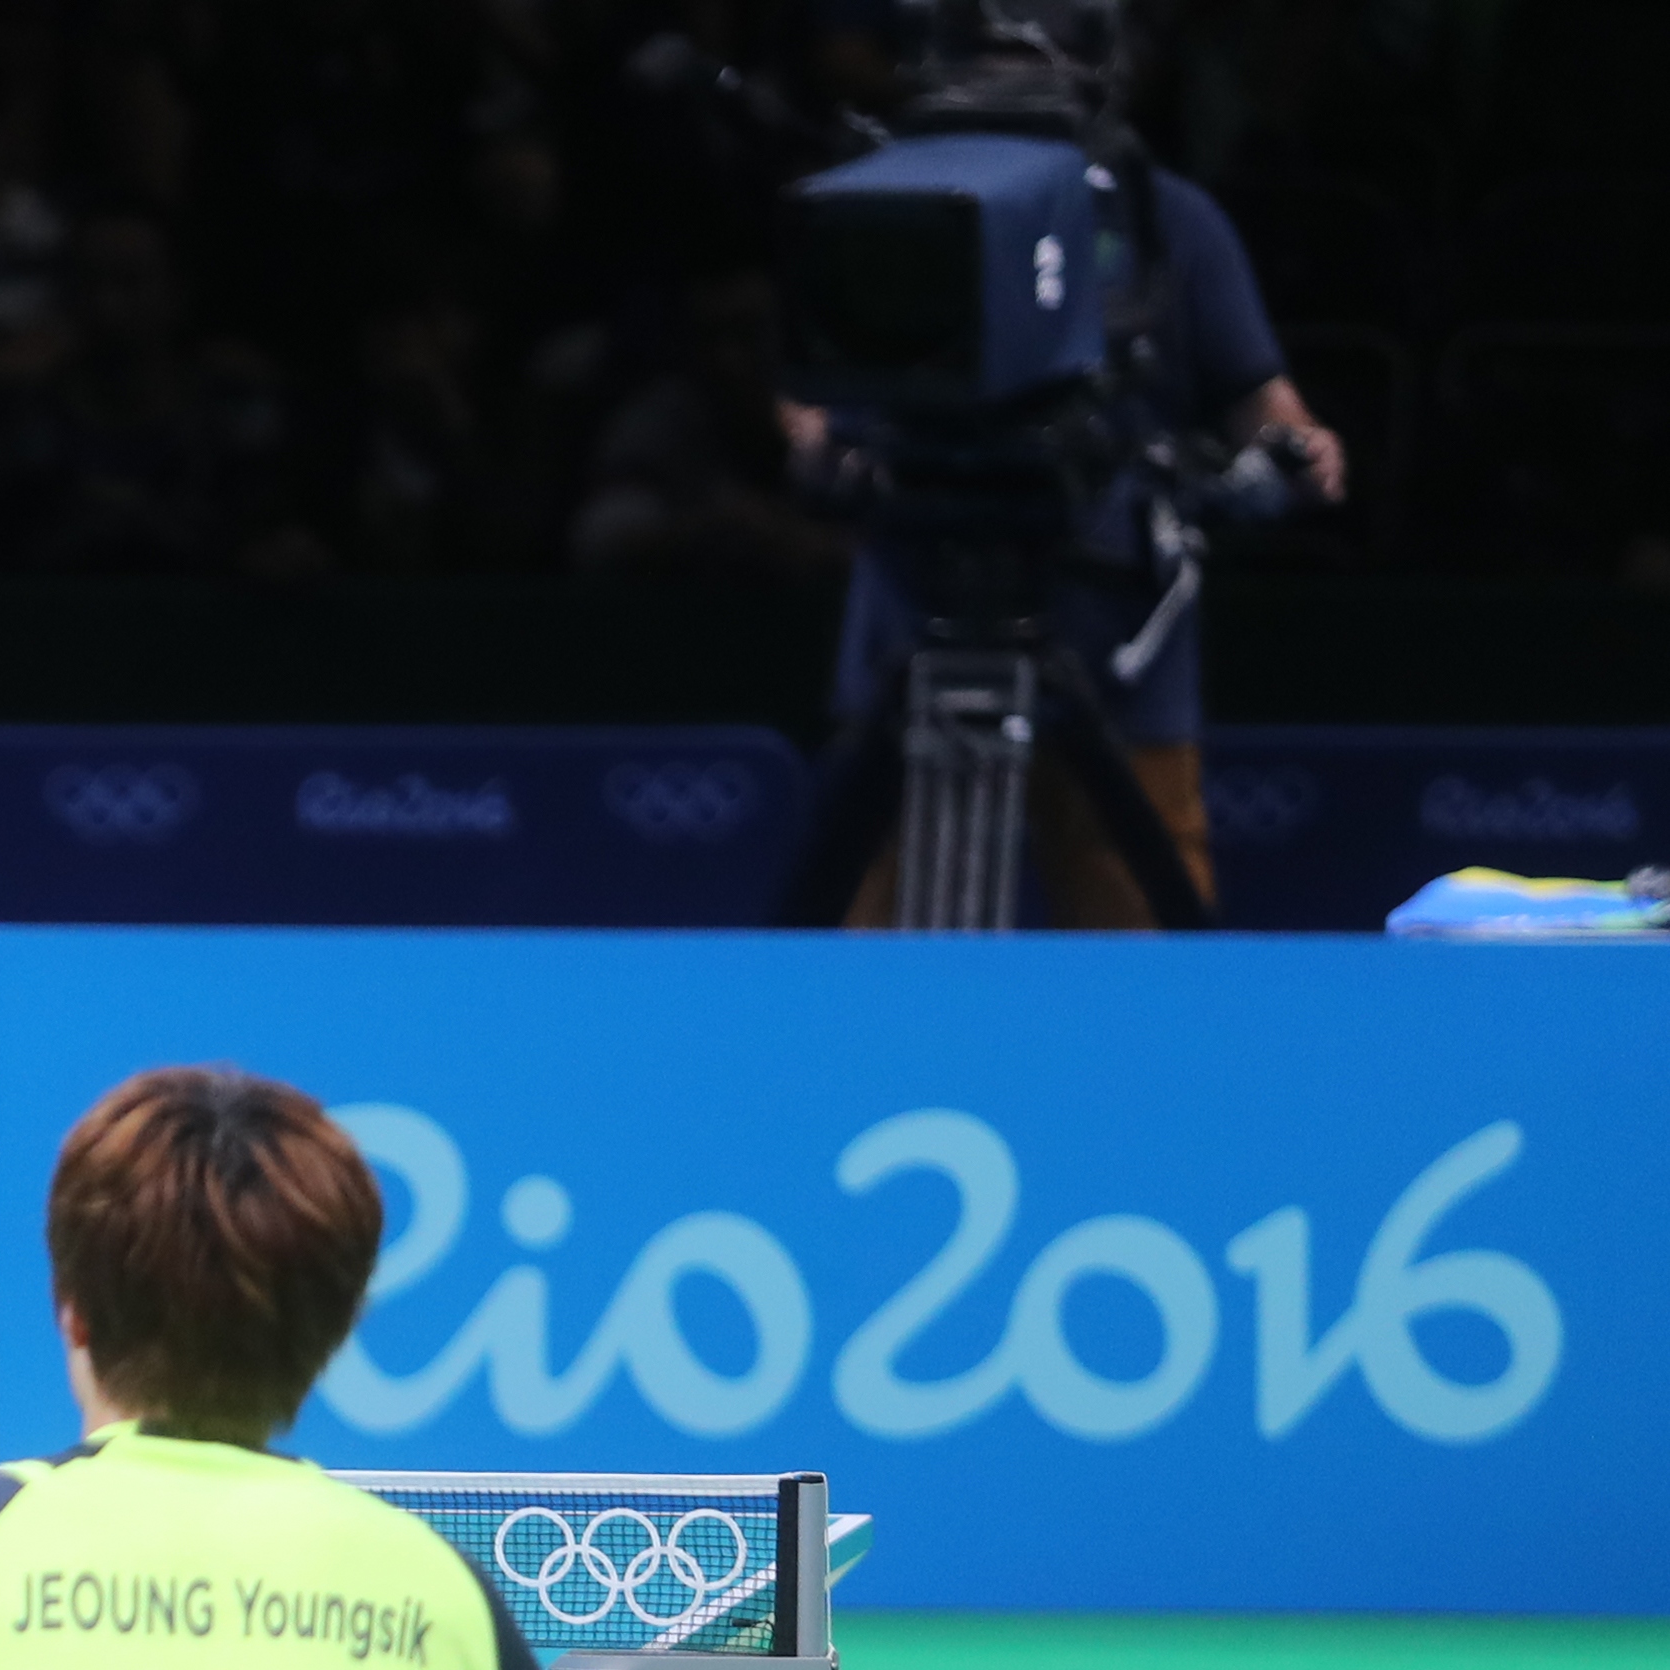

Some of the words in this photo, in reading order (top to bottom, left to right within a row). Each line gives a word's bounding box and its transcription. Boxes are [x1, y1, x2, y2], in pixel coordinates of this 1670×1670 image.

[277, 1102, 1564, 1443] Rio2016
[14, 1571, 215, 1638] JEOUNG
[235, 1577, 435, 1669] Youngsik
